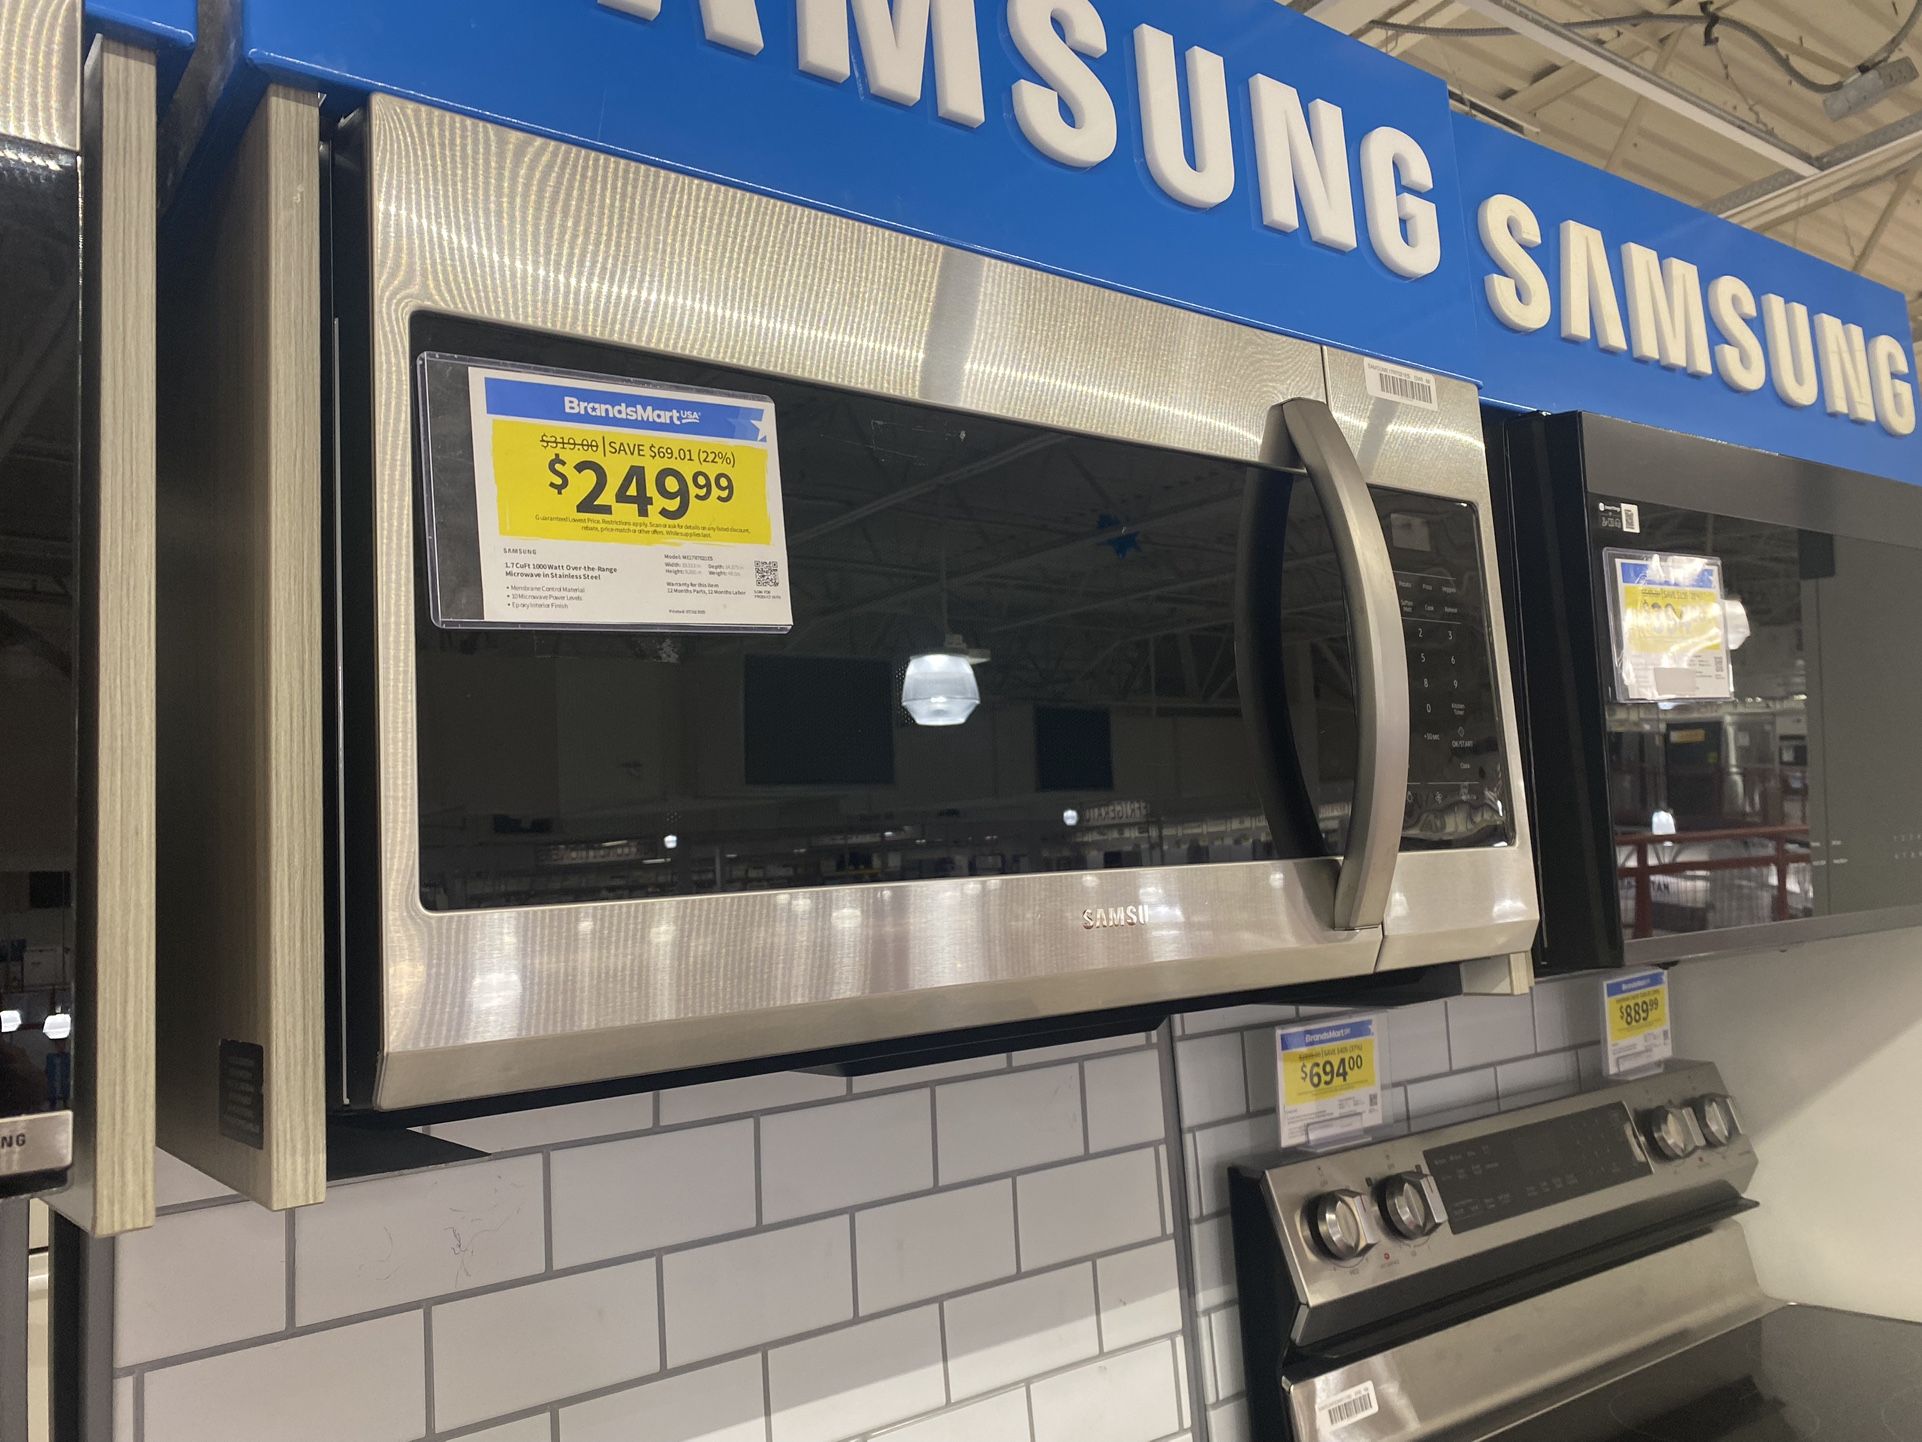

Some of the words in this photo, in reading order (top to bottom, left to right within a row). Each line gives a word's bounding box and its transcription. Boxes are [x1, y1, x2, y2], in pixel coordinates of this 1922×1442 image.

[597, 0, 1441, 281] MSUNG
[1477, 194, 1916, 436] SAMSUNG
[564, 396, 680, 424] BrandsMart
[609, 441, 645, 457] SAVE
[649, 444, 694, 462] $69.01
[698, 448, 736, 468] (22%)
[505, 570, 541, 578] Microwave
[550, 572, 582, 580] Stainless
[1082, 904, 1151, 930] SAMSU
